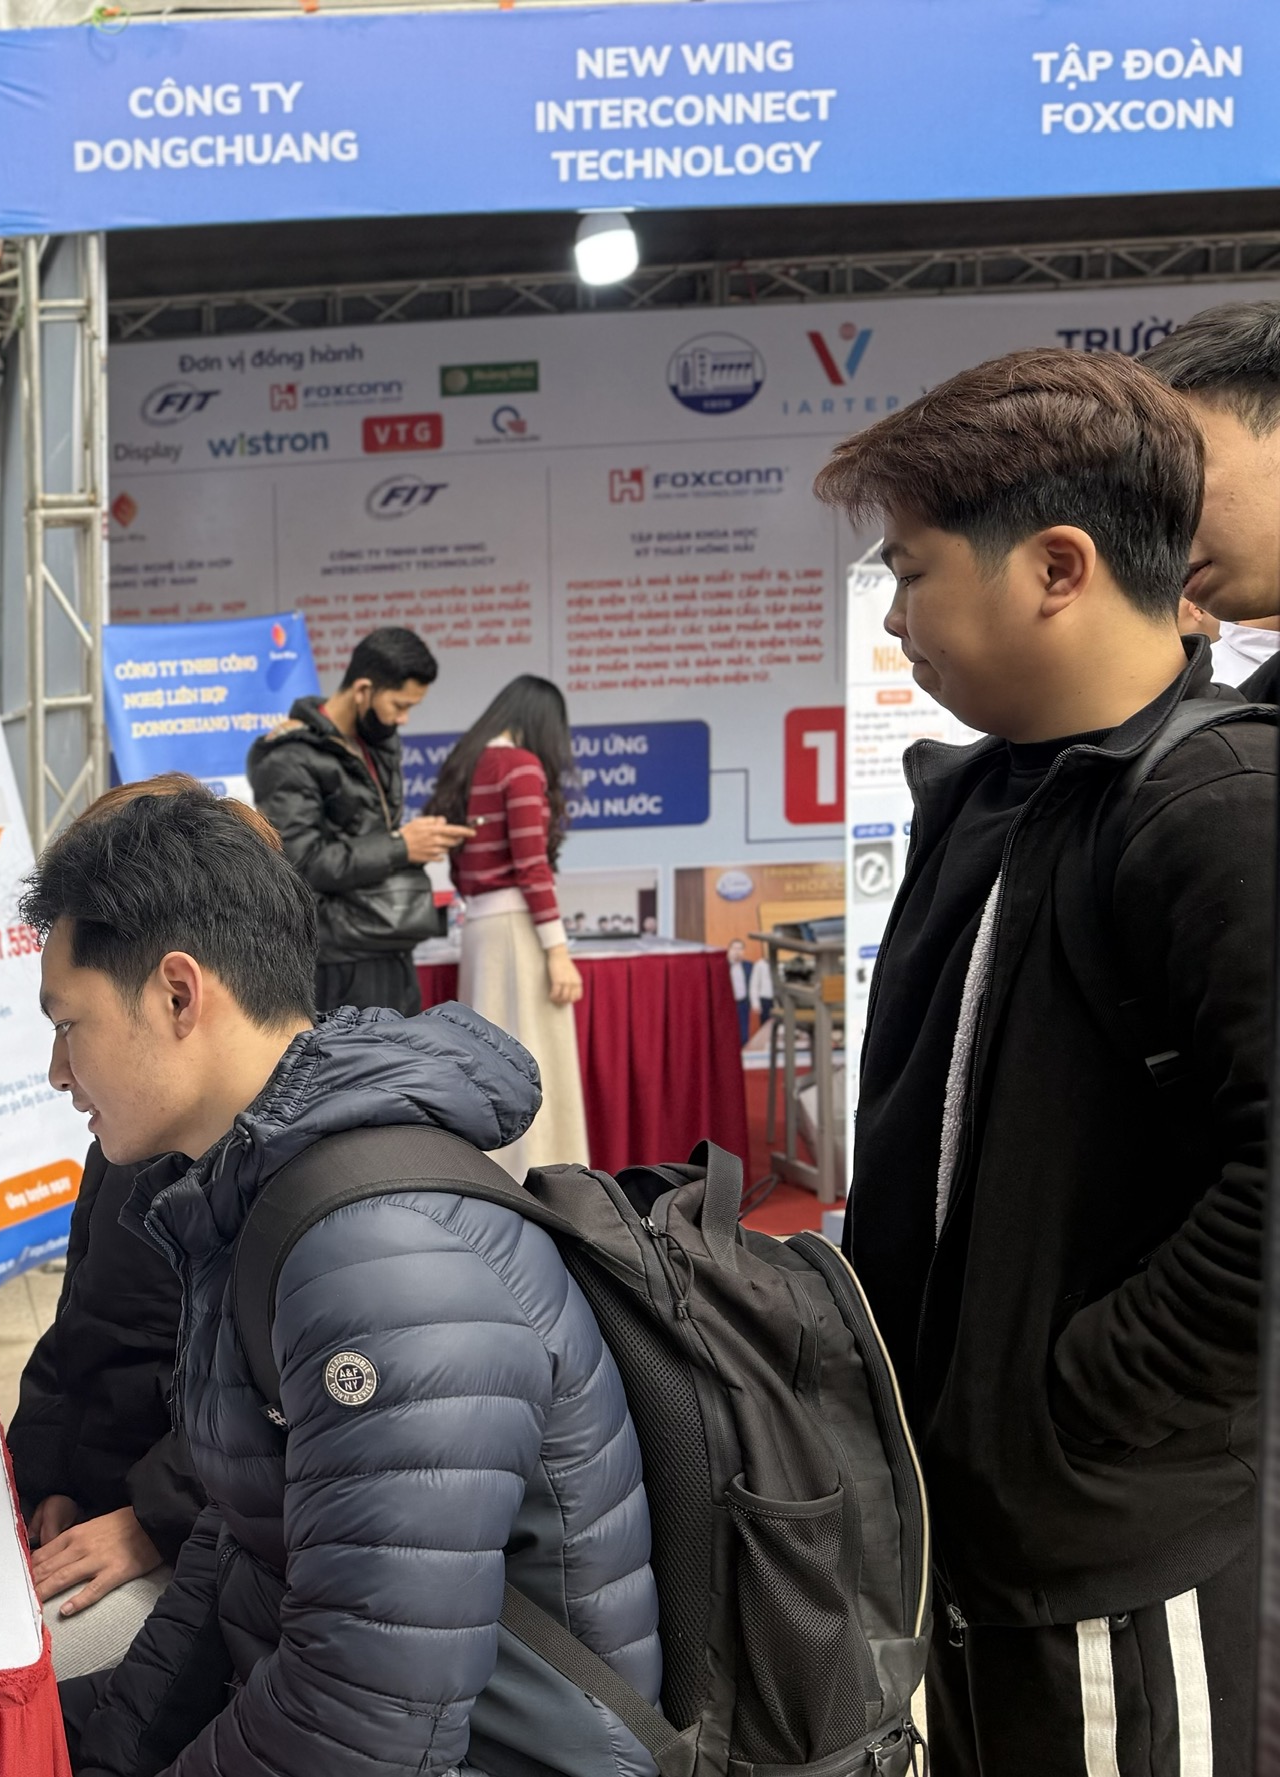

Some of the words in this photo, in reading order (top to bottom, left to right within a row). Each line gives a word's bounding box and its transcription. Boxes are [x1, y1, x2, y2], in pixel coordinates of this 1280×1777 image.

[576, 45, 671, 79] NEW
[681, 40, 794, 75] WING
[1033, 43, 1113, 90] TẬP
[1122, 38, 1242, 80] ĐOÀN
[129, 77, 241, 118] CÔNG
[250, 81, 303, 113] TY
[535, 89, 837, 132] INTERCONNECT
[1042, 97, 1233, 135] FOXCONN
[74, 130, 358, 172] DONGCHUANG
[551, 141, 821, 181] TECHNOLOGY
[207, 430, 329, 459] wistron
[373, 422, 432, 445] VTG
[653, 467, 783, 489] FOXCONN
[328, 1355, 372, 1378] ABERCROMBIE
[340, 1368, 358, 1378] A&F
[330, 1383, 350, 1402] DOWN
[352, 1378, 373, 1402] SERIES
[344, 1381, 358, 1390] NY
